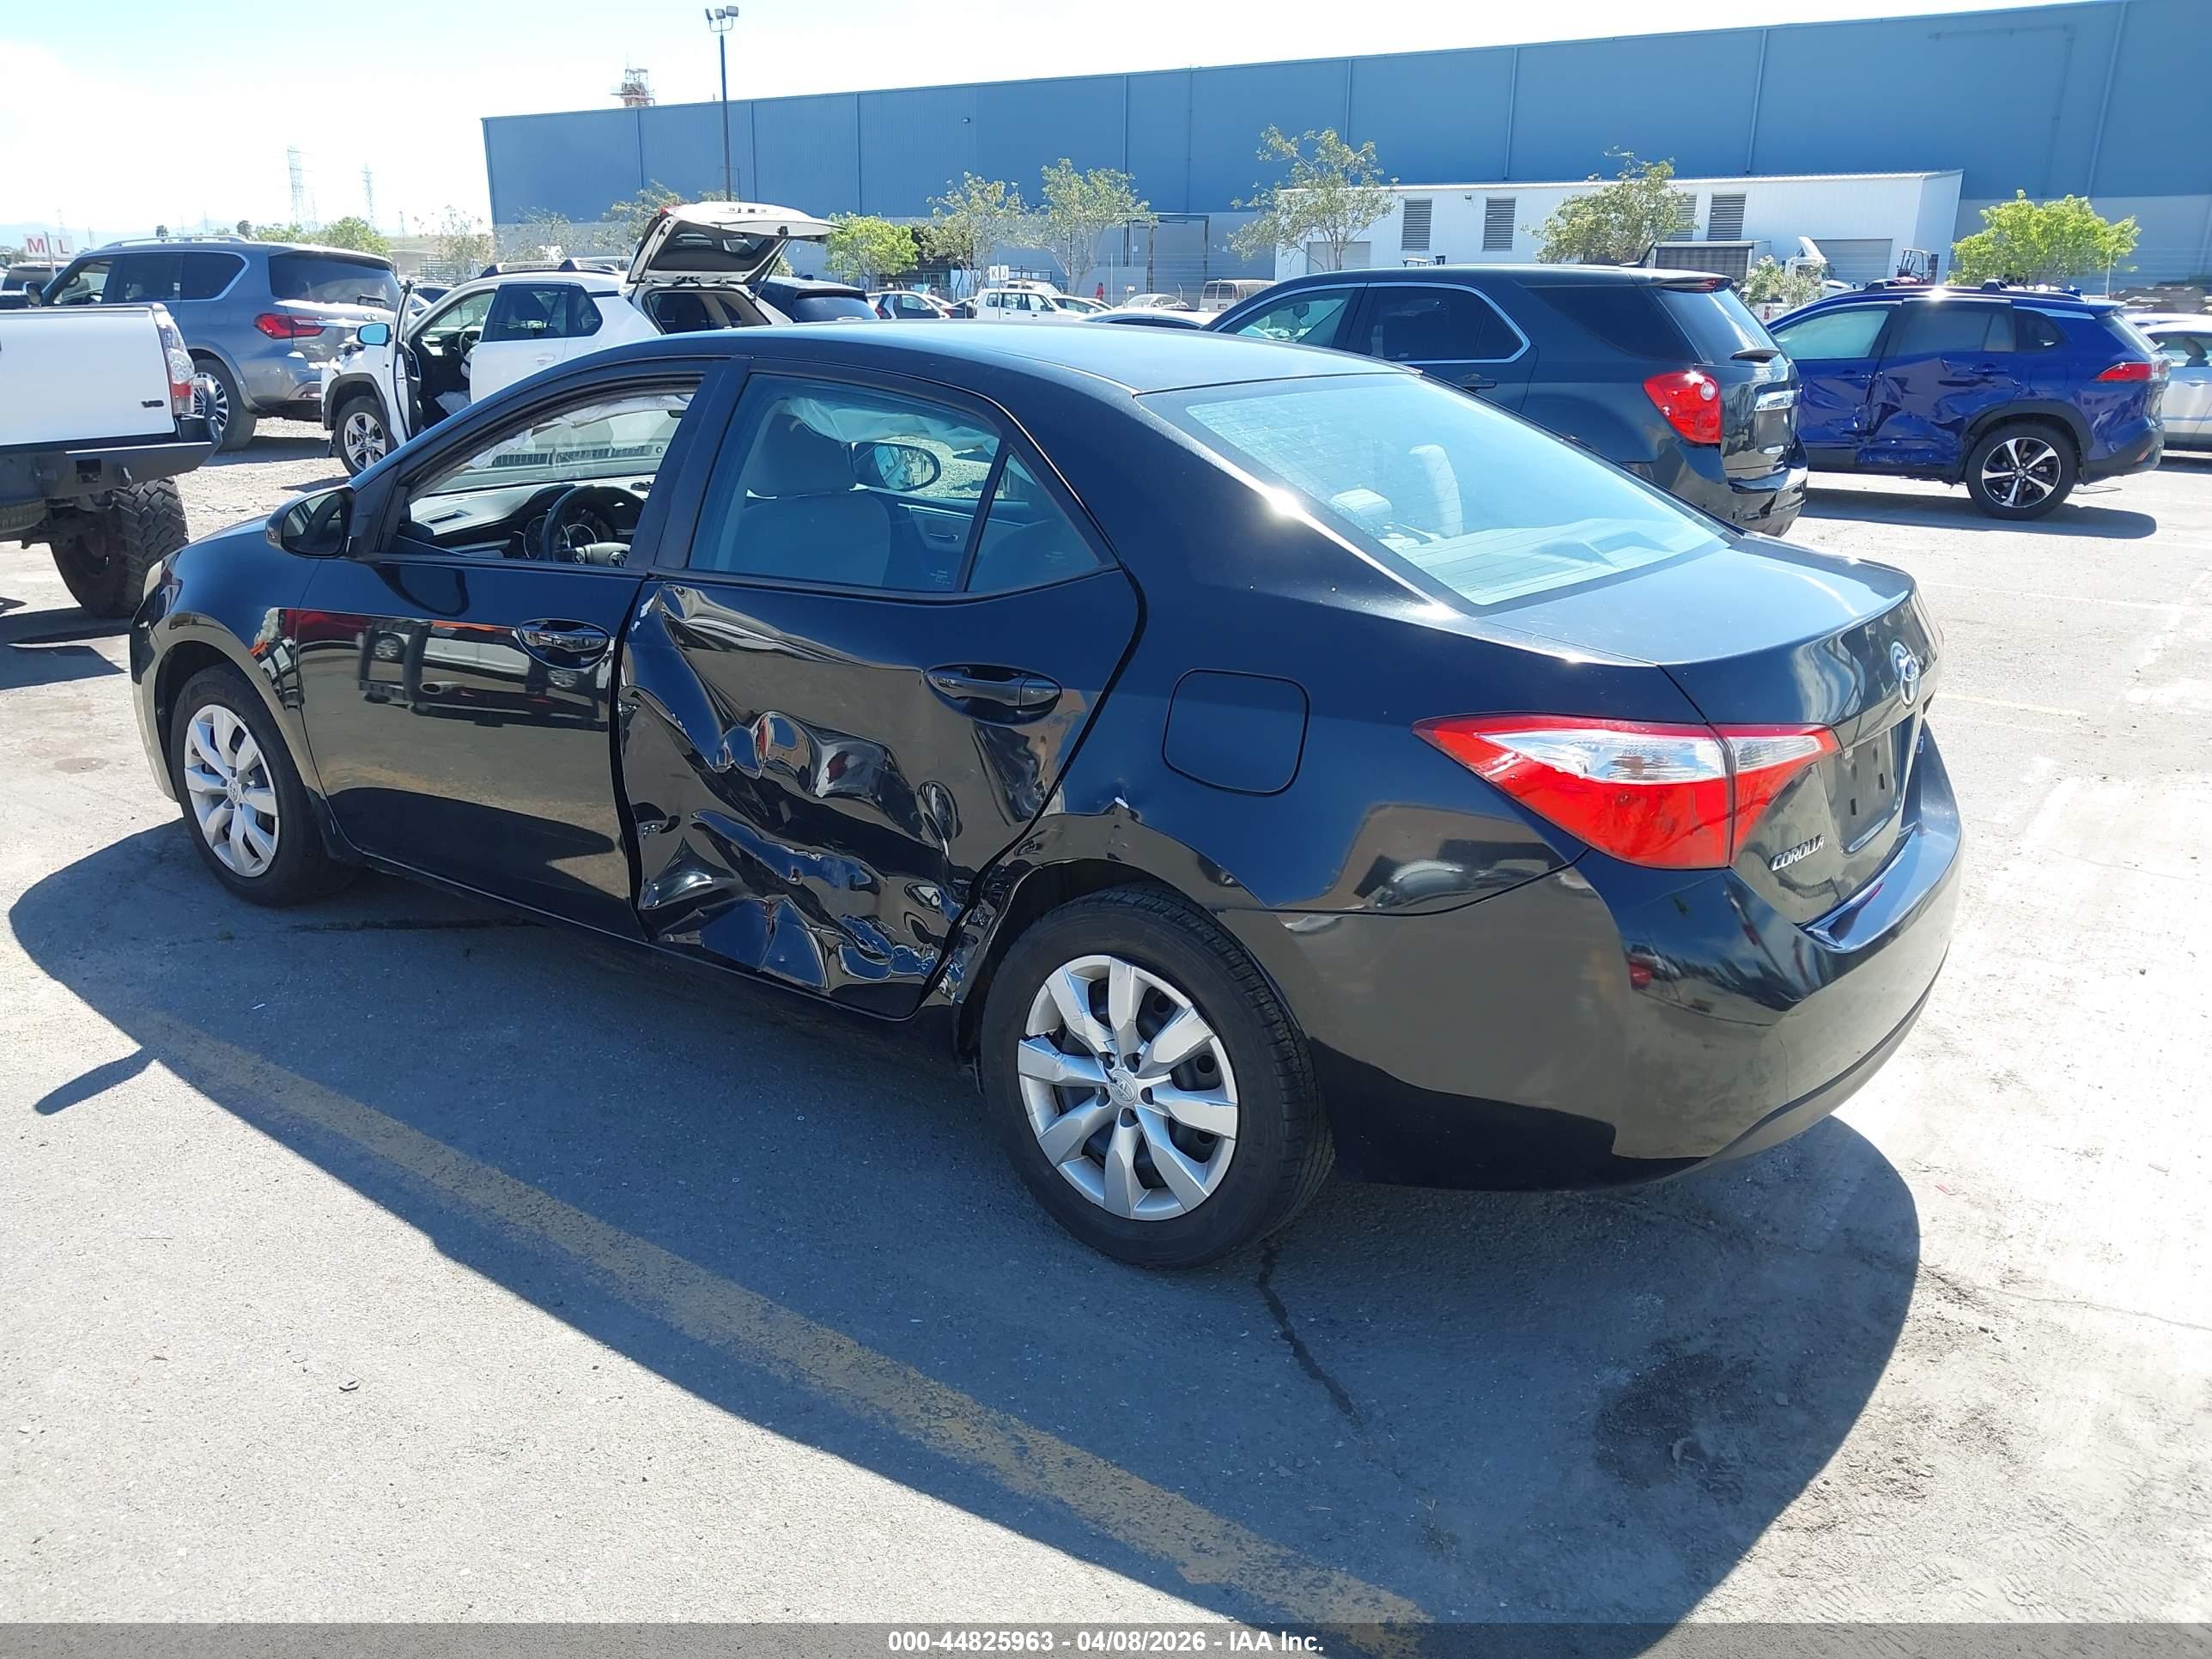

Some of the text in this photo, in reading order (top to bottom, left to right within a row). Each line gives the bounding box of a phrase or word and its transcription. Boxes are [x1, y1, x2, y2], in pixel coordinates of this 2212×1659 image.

[27, 238, 46, 253] M
[58, 240, 70, 254] L
[991, 268, 997, 279] K
[1771, 834, 1825, 872] COROLLA
